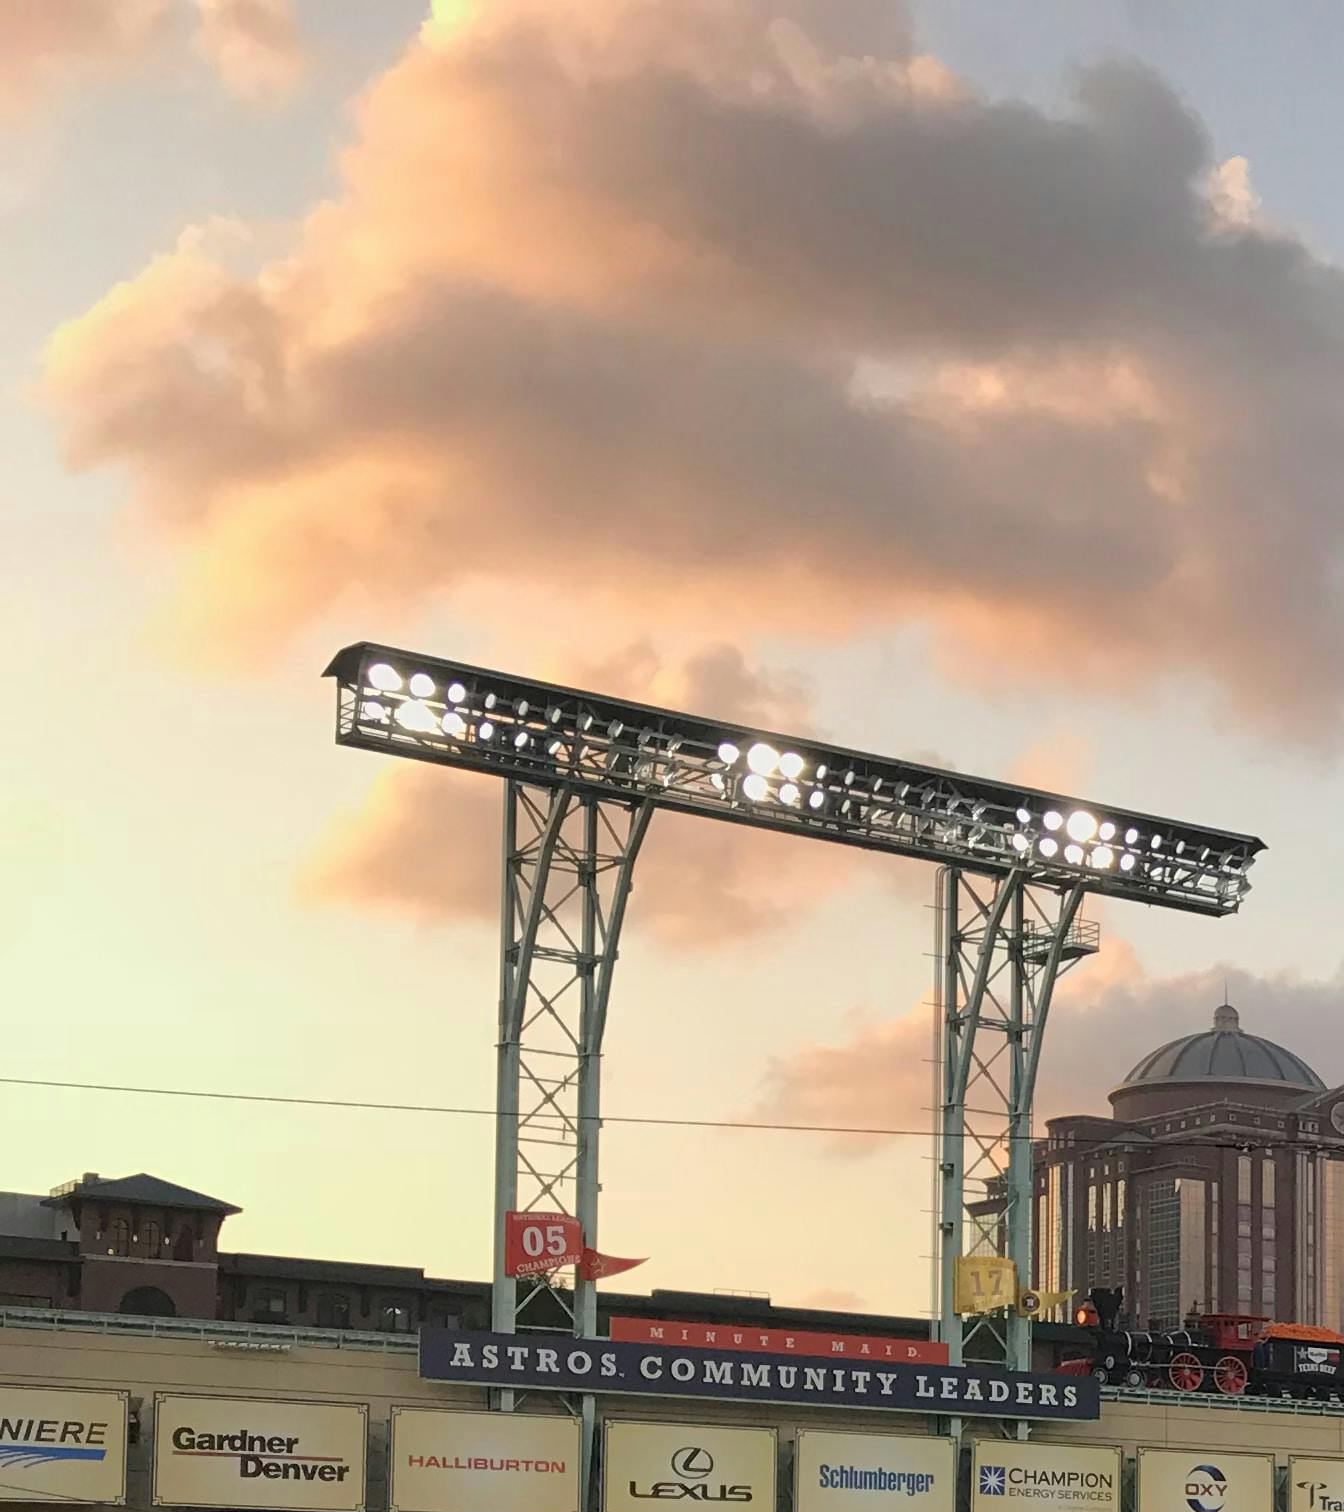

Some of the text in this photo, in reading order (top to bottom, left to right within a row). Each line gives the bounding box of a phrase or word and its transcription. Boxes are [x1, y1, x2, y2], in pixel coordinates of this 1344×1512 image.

[523, 1226, 566, 1256] 05
[517, 1254, 581, 1274] CHAMPIONS
[969, 1270, 1003, 1298] 17
[650, 1326, 917, 1358] MINUTE MAID
[449, 1342, 1078, 1408] ASTROS COMMUNITY LEADERS
[172, 1426, 299, 1456] Gardner
[240, 1454, 349, 1483] Denver
[408, 1452, 566, 1474] HALLIBURTON
[630, 1481, 752, 1502] LEXUS
[819, 1464, 934, 1497] Schlumberger
[1008, 1468, 1112, 1489] CHAMPION
[1185, 1483, 1228, 1497] OXY
[1008, 1487, 1112, 1502] ENERGY SERVICES
